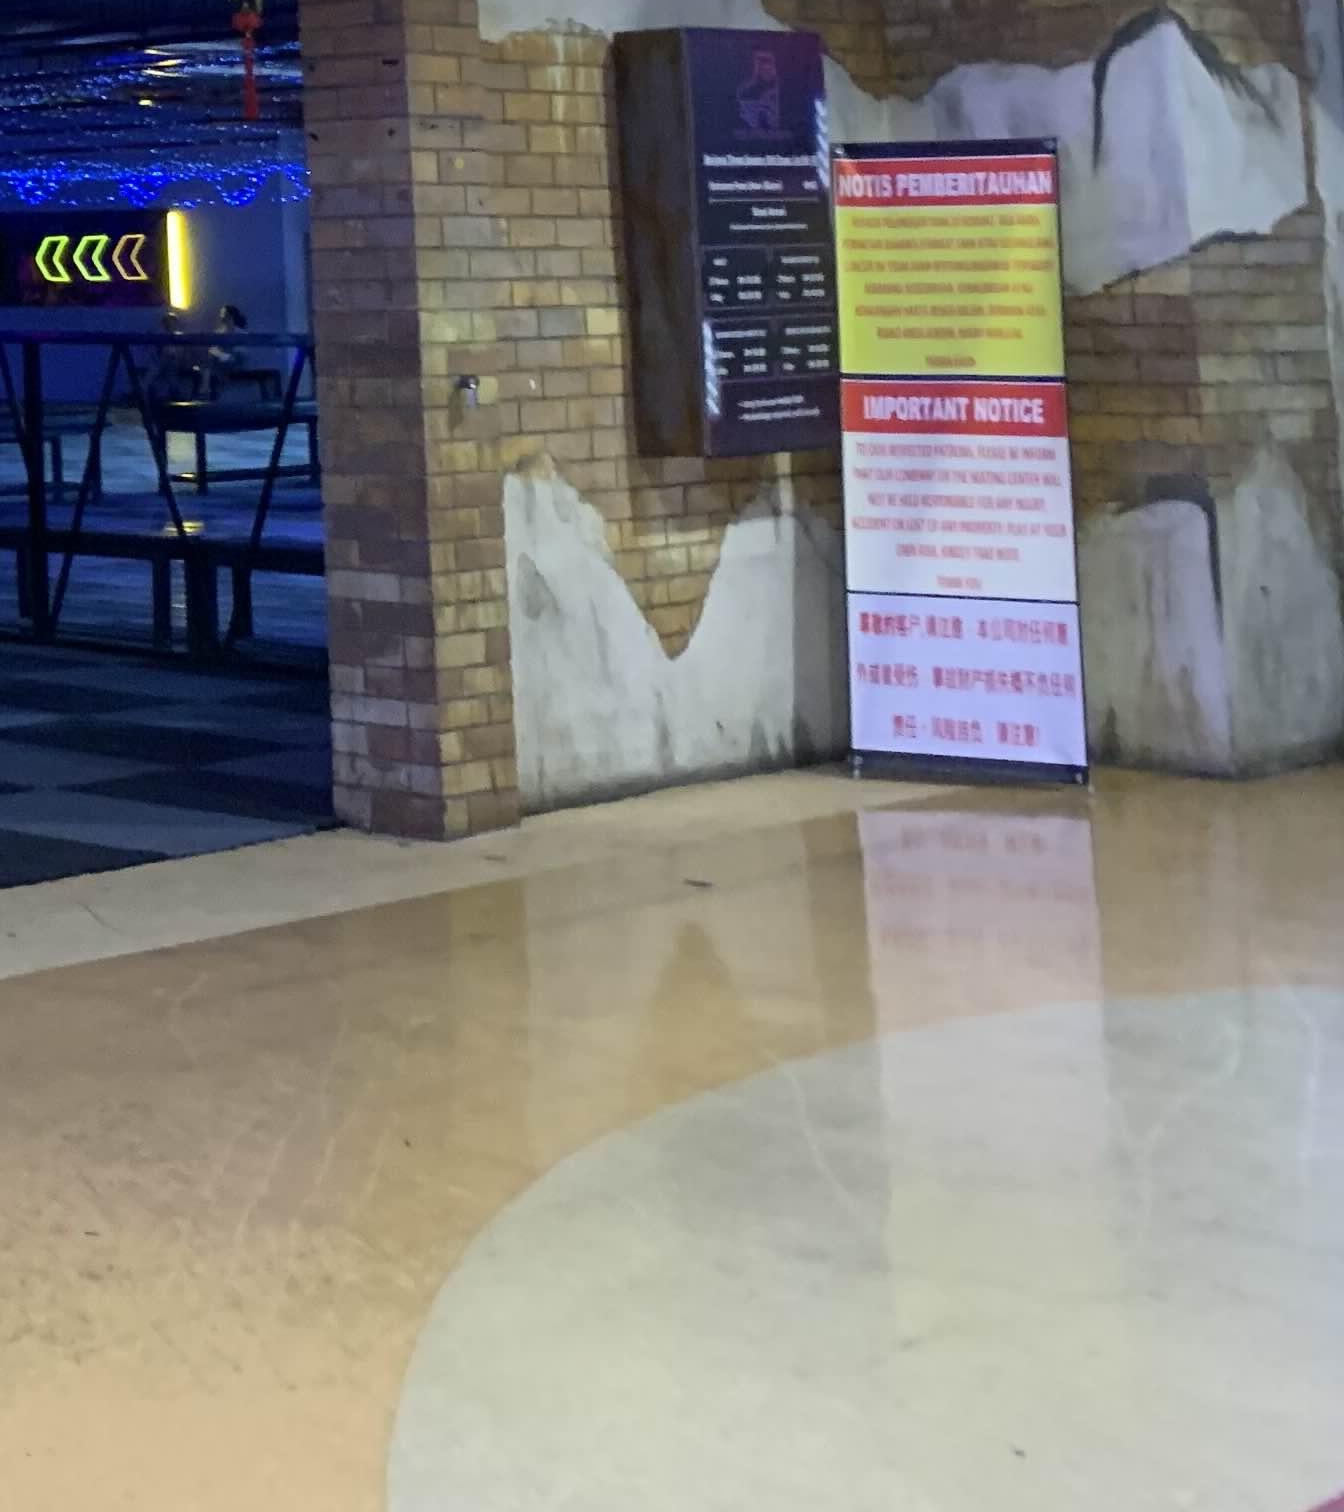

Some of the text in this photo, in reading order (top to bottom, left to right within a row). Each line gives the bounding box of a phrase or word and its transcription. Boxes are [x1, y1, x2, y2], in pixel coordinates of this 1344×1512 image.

[838, 173, 893, 198] NOTIS
[863, 395, 1045, 424] IMPORTANT NOTICE
